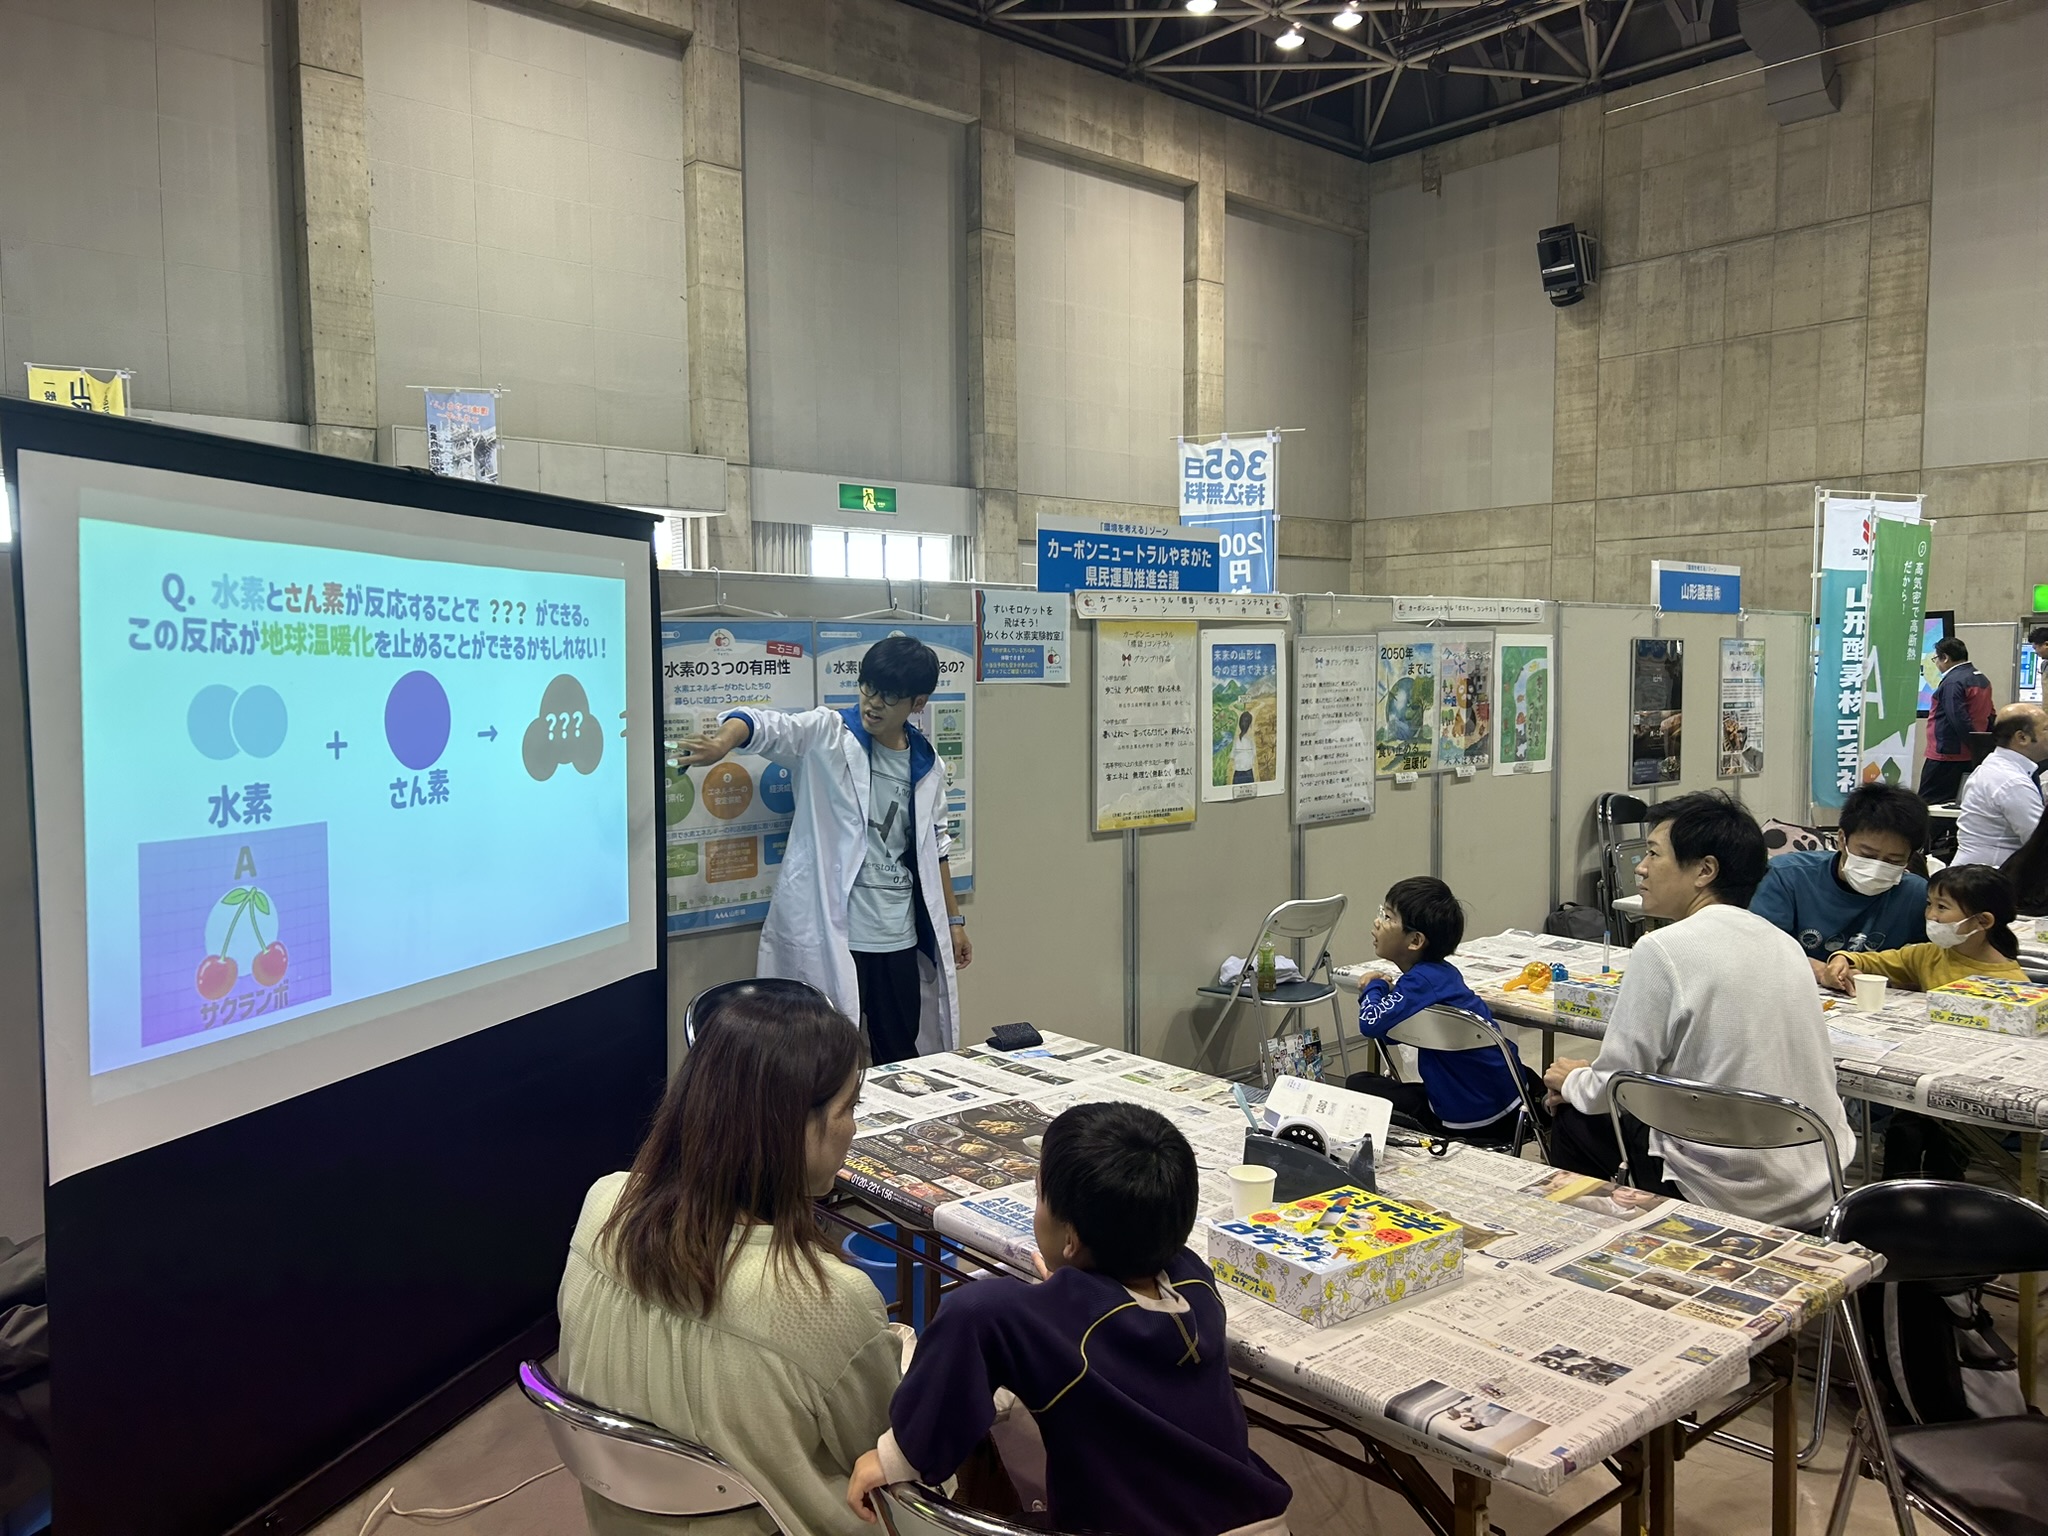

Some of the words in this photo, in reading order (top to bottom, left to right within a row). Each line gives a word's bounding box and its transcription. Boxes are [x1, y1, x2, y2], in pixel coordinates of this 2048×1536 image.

[1101, 522, 1169, 536] 「環境を考える」ゾーン
[1048, 538, 1212, 568] カーボンニュートラルやまがた
[1085, 566, 1179, 590] 県民運動推進会議
[162, 573, 195, 612] Q.
[211, 573, 480, 623] 水素とさん素が反応することで
[536, 599, 590, 627] ができる。
[994, 605, 1053, 615] すいそロケットを
[1906, 562, 1924, 660] 高気密で高断熱
[1004, 618, 1039, 628] 飛ばそう!
[128, 617, 606, 660] この反応が地球温暖化を止めることができるかもしれない!
[769, 644, 801, 656] 一石三鳥
[1214, 649, 1261, 661] 未来の山形は
[1381, 647, 1414, 660] 2050年
[664, 659, 791, 678] 水素の3つの有用性
[1213, 664, 1276, 676] 今の選択で決まる
[1408, 662, 1431, 674] までに
[674, 682, 771, 693] 水素エネルギーがわたしたちの
[675, 694, 771, 705] 暮らしに役立つ3つのポイント
[546, 711, 584, 740] ???
[1378, 742, 1419, 758] 食い止める
[1403, 757, 1427, 770] 温暖化
[389, 769, 450, 809] さん素
[208, 783, 272, 828] 水素
[234, 846, 257, 880] A
[201, 979, 289, 1029] サクランボ
[1929, 1093, 1995, 1117] PRESIDENT
[851, 1173, 892, 1201] 0120-221-156
[1231, 1275, 1262, 1295] ロケット
